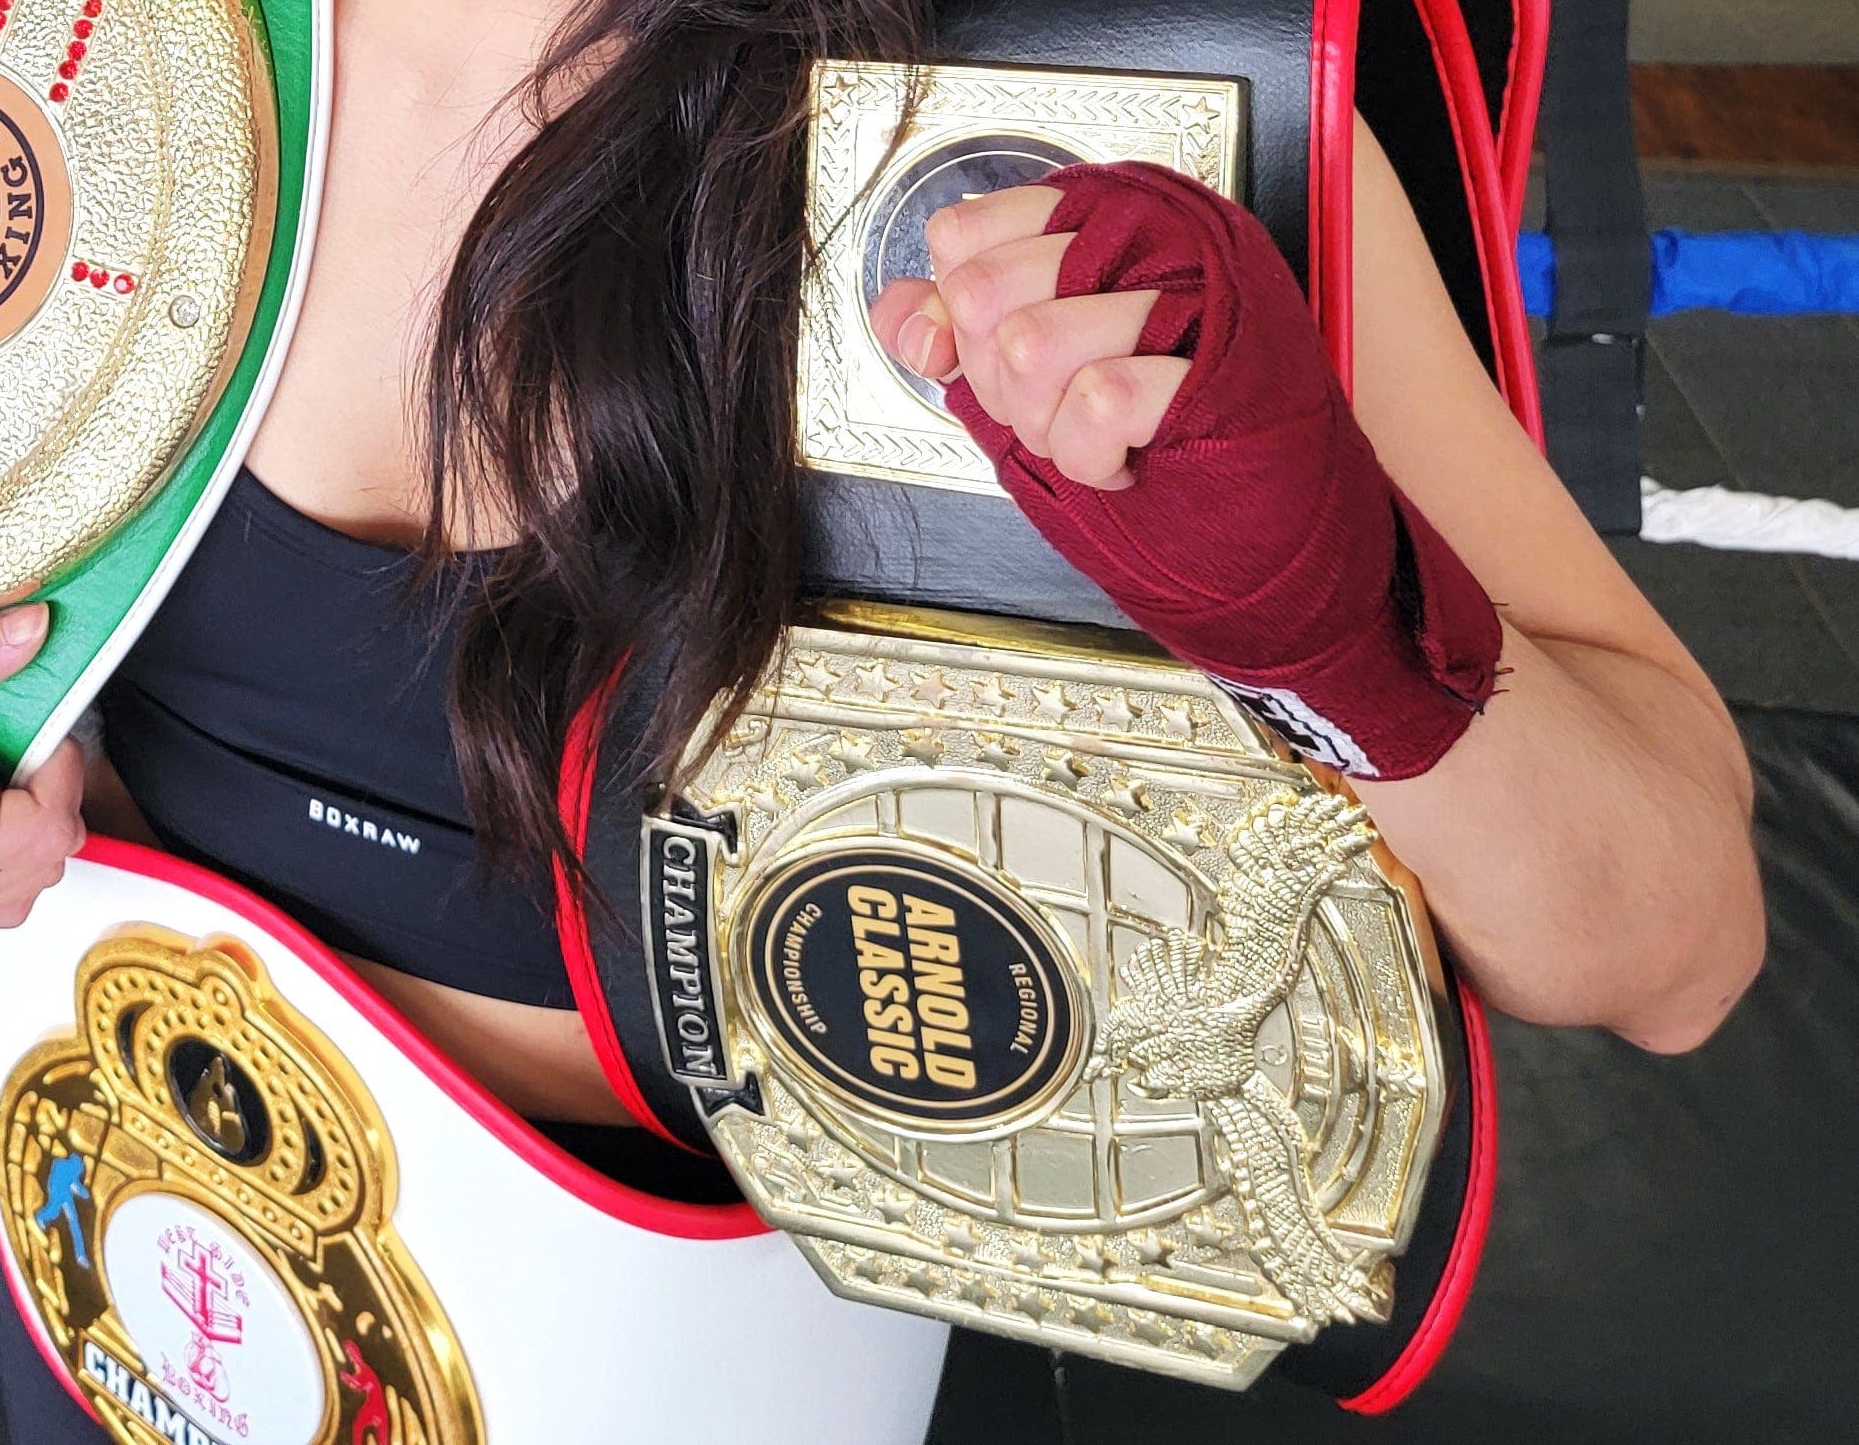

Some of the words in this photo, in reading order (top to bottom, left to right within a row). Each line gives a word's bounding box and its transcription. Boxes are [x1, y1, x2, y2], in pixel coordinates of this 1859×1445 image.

[308, 797, 422, 855] BOXRAW
[661, 834, 728, 1082] CHAMPION
[782, 901, 829, 1036] CHAMPIONSHIP
[846, 883, 922, 1081] CLASSIC
[901, 892, 979, 1092] ARNOLD
[1007, 961, 1042, 1056] REGIONAL
[84, 1341, 224, 1444] CHAMP
